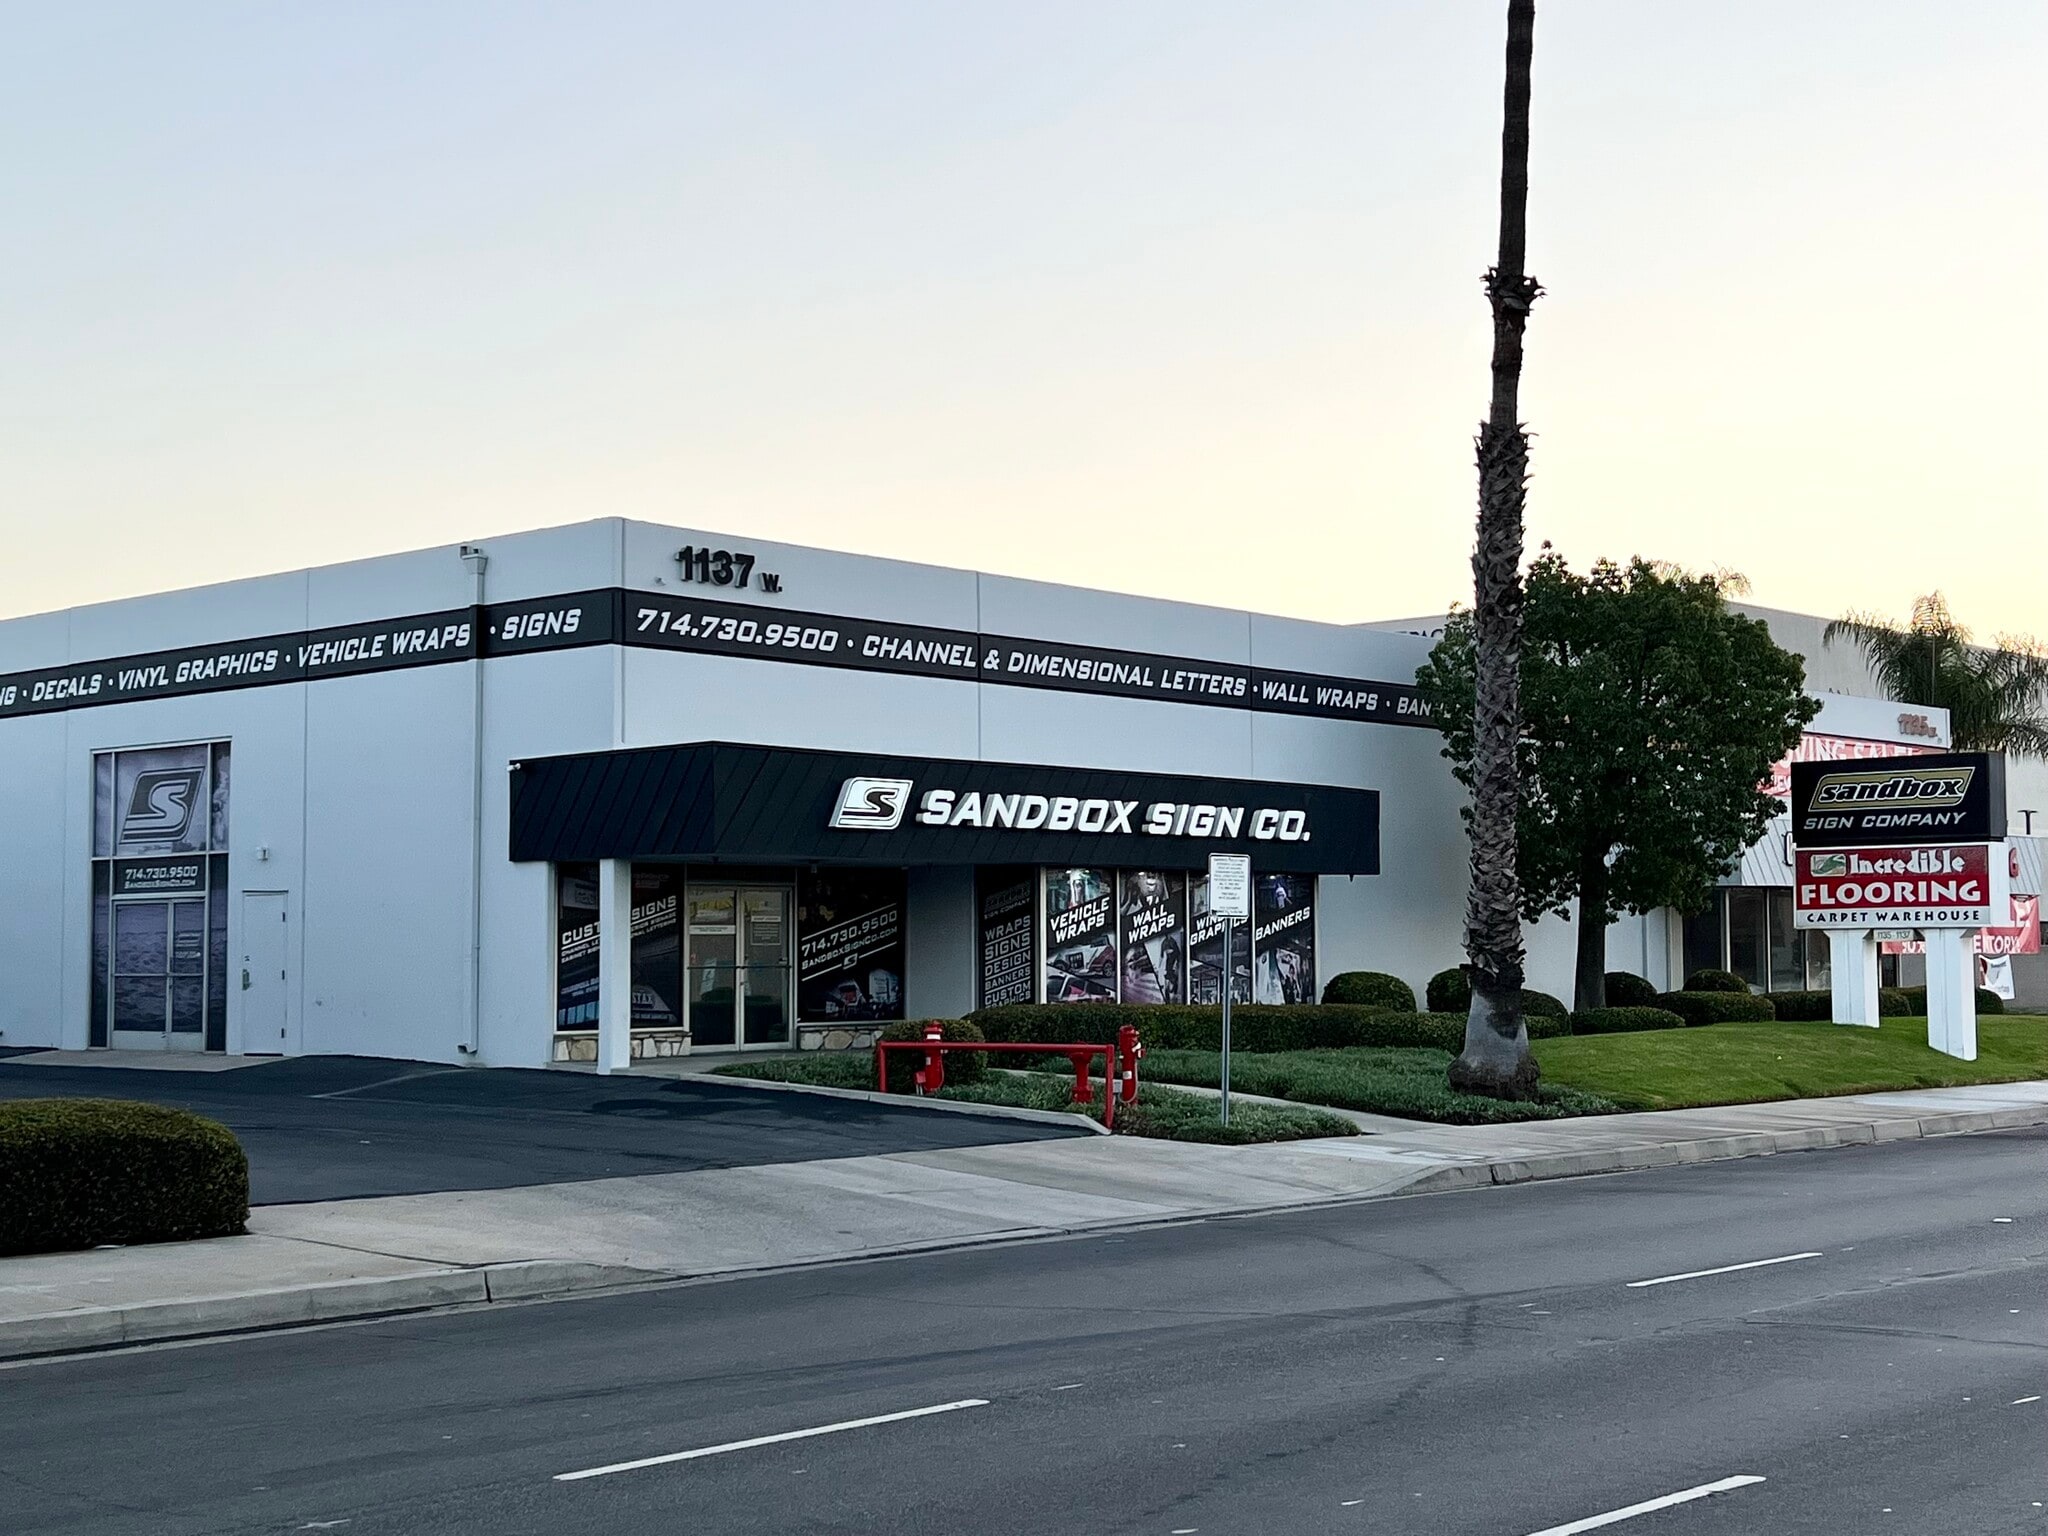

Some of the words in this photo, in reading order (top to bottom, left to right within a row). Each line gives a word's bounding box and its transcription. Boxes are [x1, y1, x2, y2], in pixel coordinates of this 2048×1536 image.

[676, 545, 755, 588] 1137
[31, 673, 102, 702] DECALS
[118, 665, 169, 691] VINYL
[175, 649, 279, 683] GRAPHICS
[298, 633, 387, 667] VEHICLE
[391, 623, 471, 655] WRAPS
[501, 608, 582, 640] SIGNS
[637, 608, 839, 652] 714.730.9500
[862, 634, 977, 668] CHANNEL
[983, 649, 1000, 670] &
[1007, 651, 1154, 687] DIMENSIONAL
[1160, 669, 1247, 696] LETTERS
[1262, 680, 1310, 703] WALL
[1316, 686, 1379, 711] WRAPS
[1396, 696, 1443, 718] BAN
[1818, 777, 1964, 802] sandbox
[916, 789, 1139, 833] SANDBOX
[1142, 803, 1245, 838] SIGN
[1248, 808, 1311, 841] CO.
[1803, 815, 1854, 830] SIGN
[1861, 812, 1967, 828] COMPANY
[125, 866, 198, 880] 714.730.9500
[1850, 850, 1965, 875] Incredible
[1801, 880, 1981, 905] FLOORING
[631, 895, 677, 920] SIGNS
[1050, 897, 1110, 931] VEHICLE
[1133, 904, 1168, 928] WALL
[1807, 911, 1869, 923] CARPET
[1876, 910, 1980, 922] WAREHOUSE
[801, 910, 897, 957] 714.730.9500
[985, 915, 1031, 941] WRAPS
[1055, 912, 1105, 943] WRAPS
[1128, 913, 1175, 944] WRAPS
[1255, 906, 1311, 941] BANNERS
[985, 932, 1031, 960] SIGNS
[985, 950, 1031, 977] DESIGN
[985, 966, 1031, 991] BANNERS
[985, 980, 1031, 1005] CUSTOM
